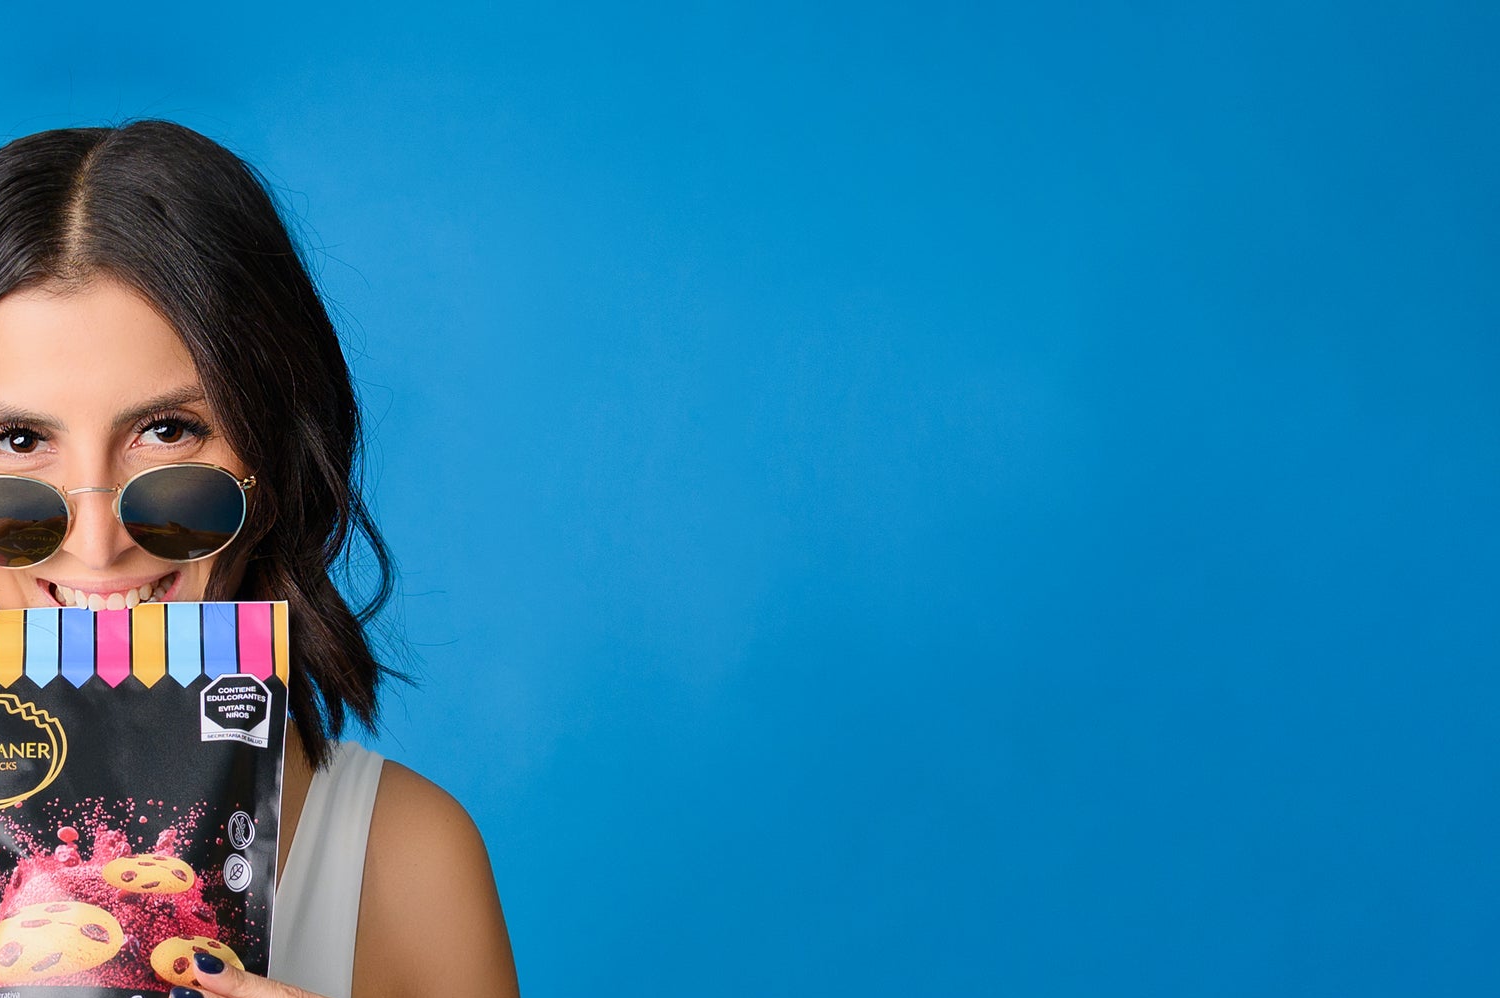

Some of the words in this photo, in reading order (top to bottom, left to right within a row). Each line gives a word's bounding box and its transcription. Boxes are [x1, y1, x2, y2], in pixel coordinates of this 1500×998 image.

[218, 686, 256, 694] CONTIENE
[206, 693, 266, 702] EDULCORANTES
[218, 704, 245, 712] EVITAR
[226, 711, 250, 719] NIÑOS
